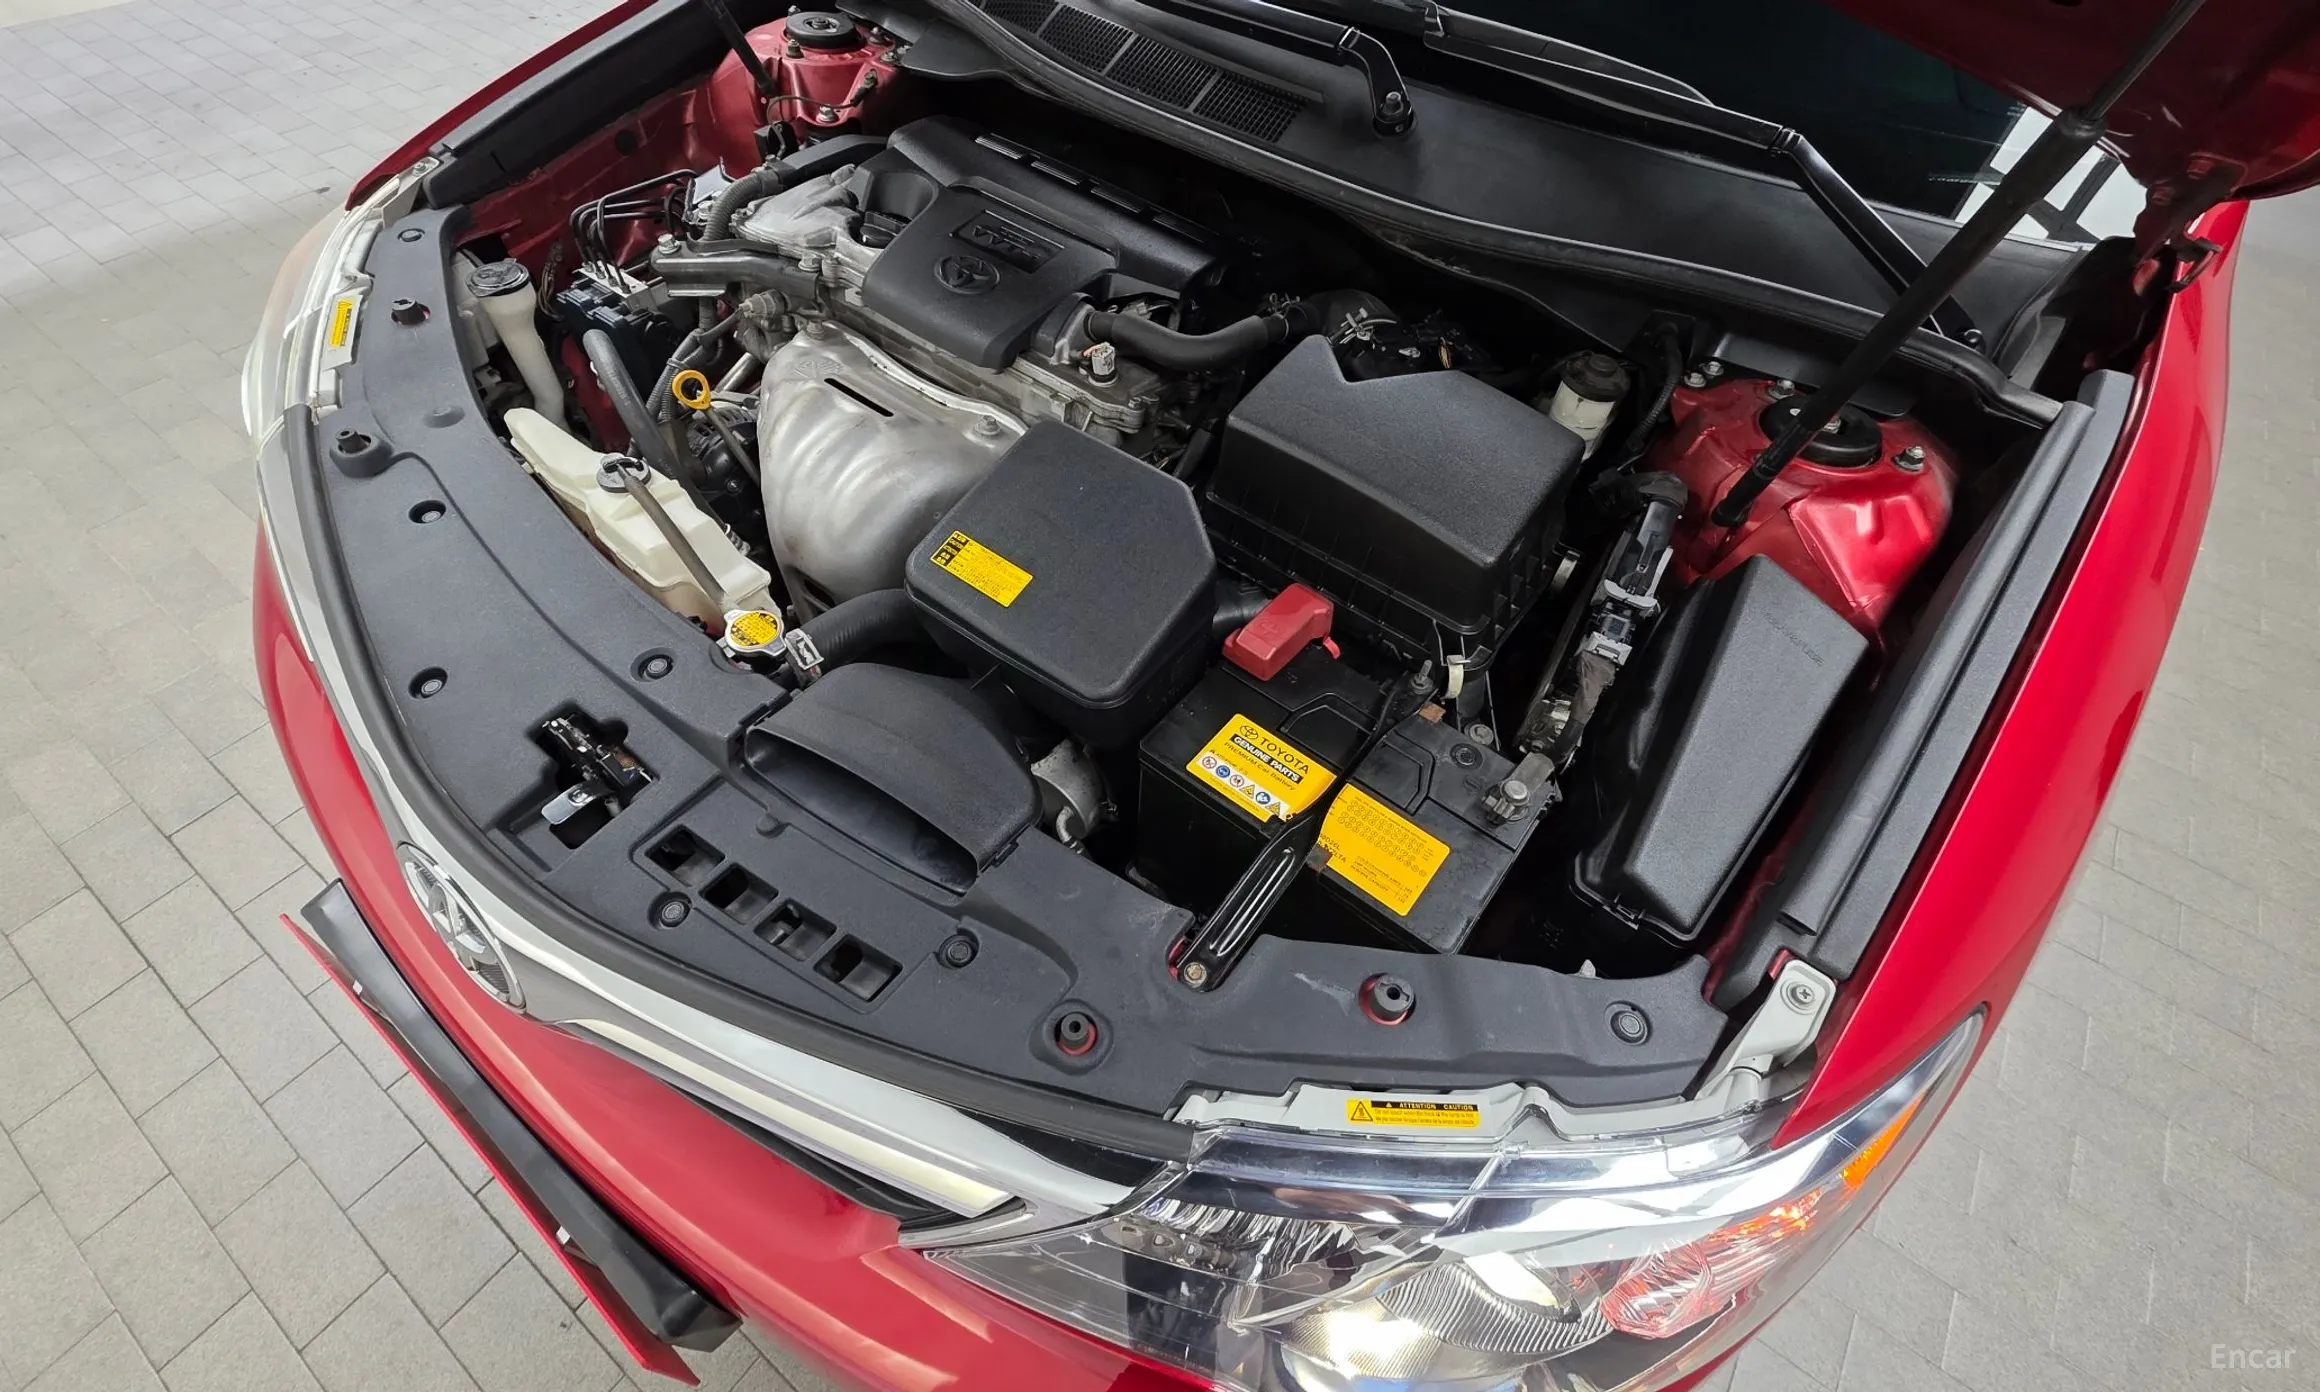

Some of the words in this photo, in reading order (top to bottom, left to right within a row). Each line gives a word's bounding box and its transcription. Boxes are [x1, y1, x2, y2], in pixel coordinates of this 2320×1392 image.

[1224, 742, 1257, 766] PREMIUM
[1257, 764, 1270, 774] Car
[1270, 772, 1296, 791] Battery
[1234, 736, 1272, 763] GENUINE
[1270, 759, 1300, 782] PARTS
[1260, 737, 1310, 774] TOYOTA
[1399, 1102, 1437, 1110] ATTENTION
